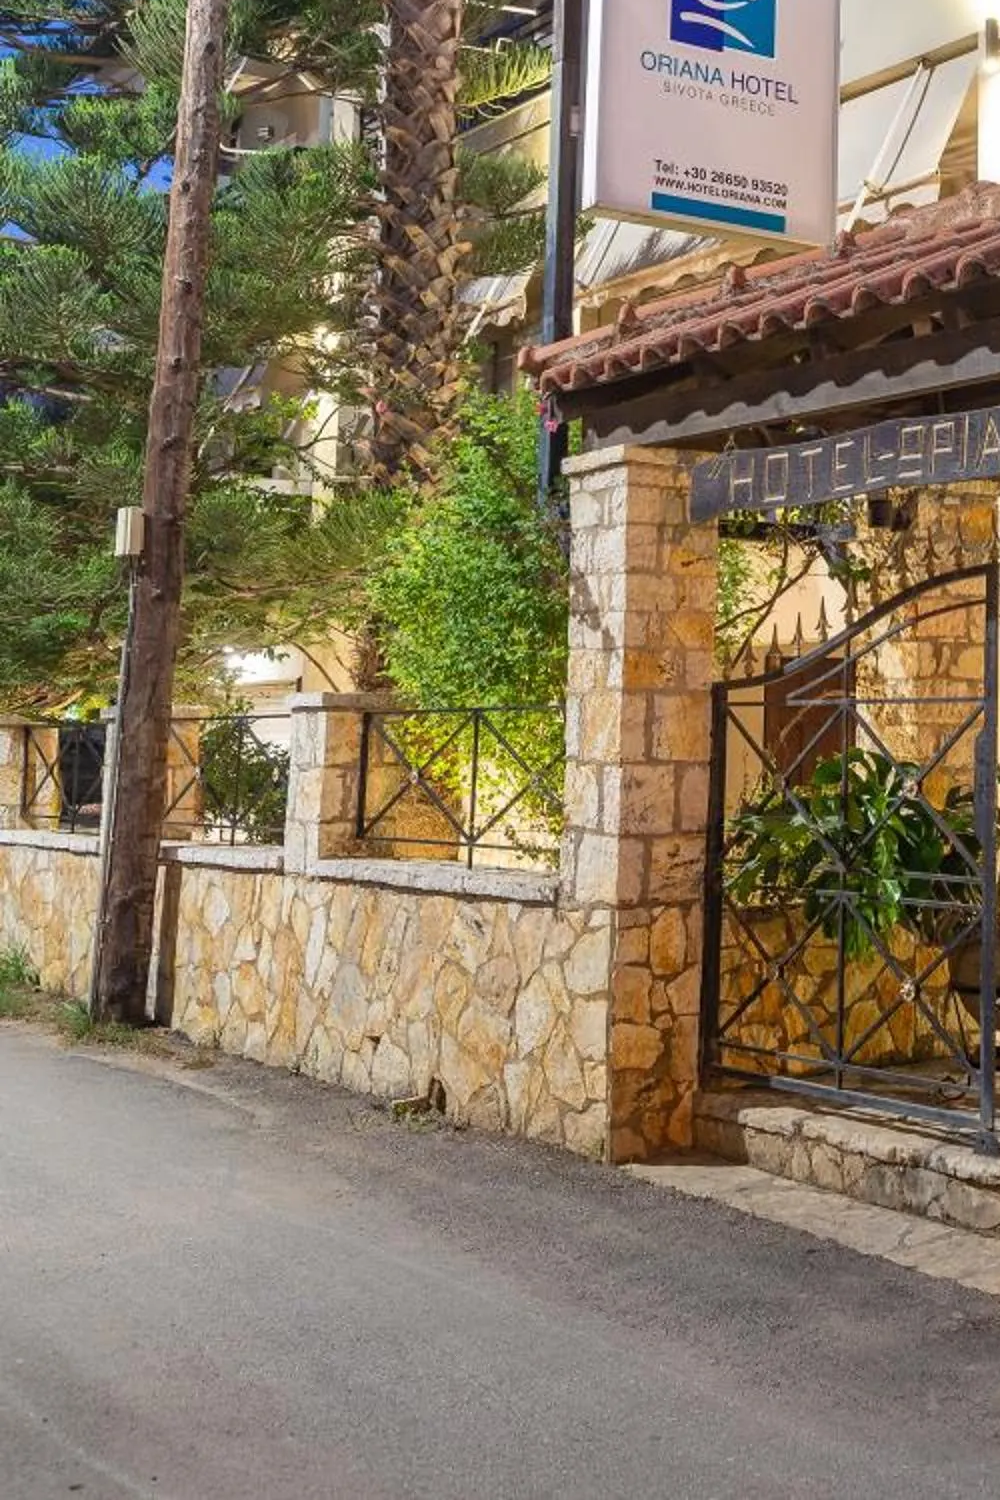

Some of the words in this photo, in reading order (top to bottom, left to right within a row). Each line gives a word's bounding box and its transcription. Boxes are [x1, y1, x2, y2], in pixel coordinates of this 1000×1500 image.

[640, 51, 725, 87] ORIANA
[731, 71, 799, 105] HOTEL
[663, 80, 713, 101] SIVOTA
[719, 93, 776, 117] GREECE
[655, 159, 679, 176] Tel:
[683, 166, 707, 182] +30
[655, 176, 787, 210] WWW.HOTELORIANA.COM
